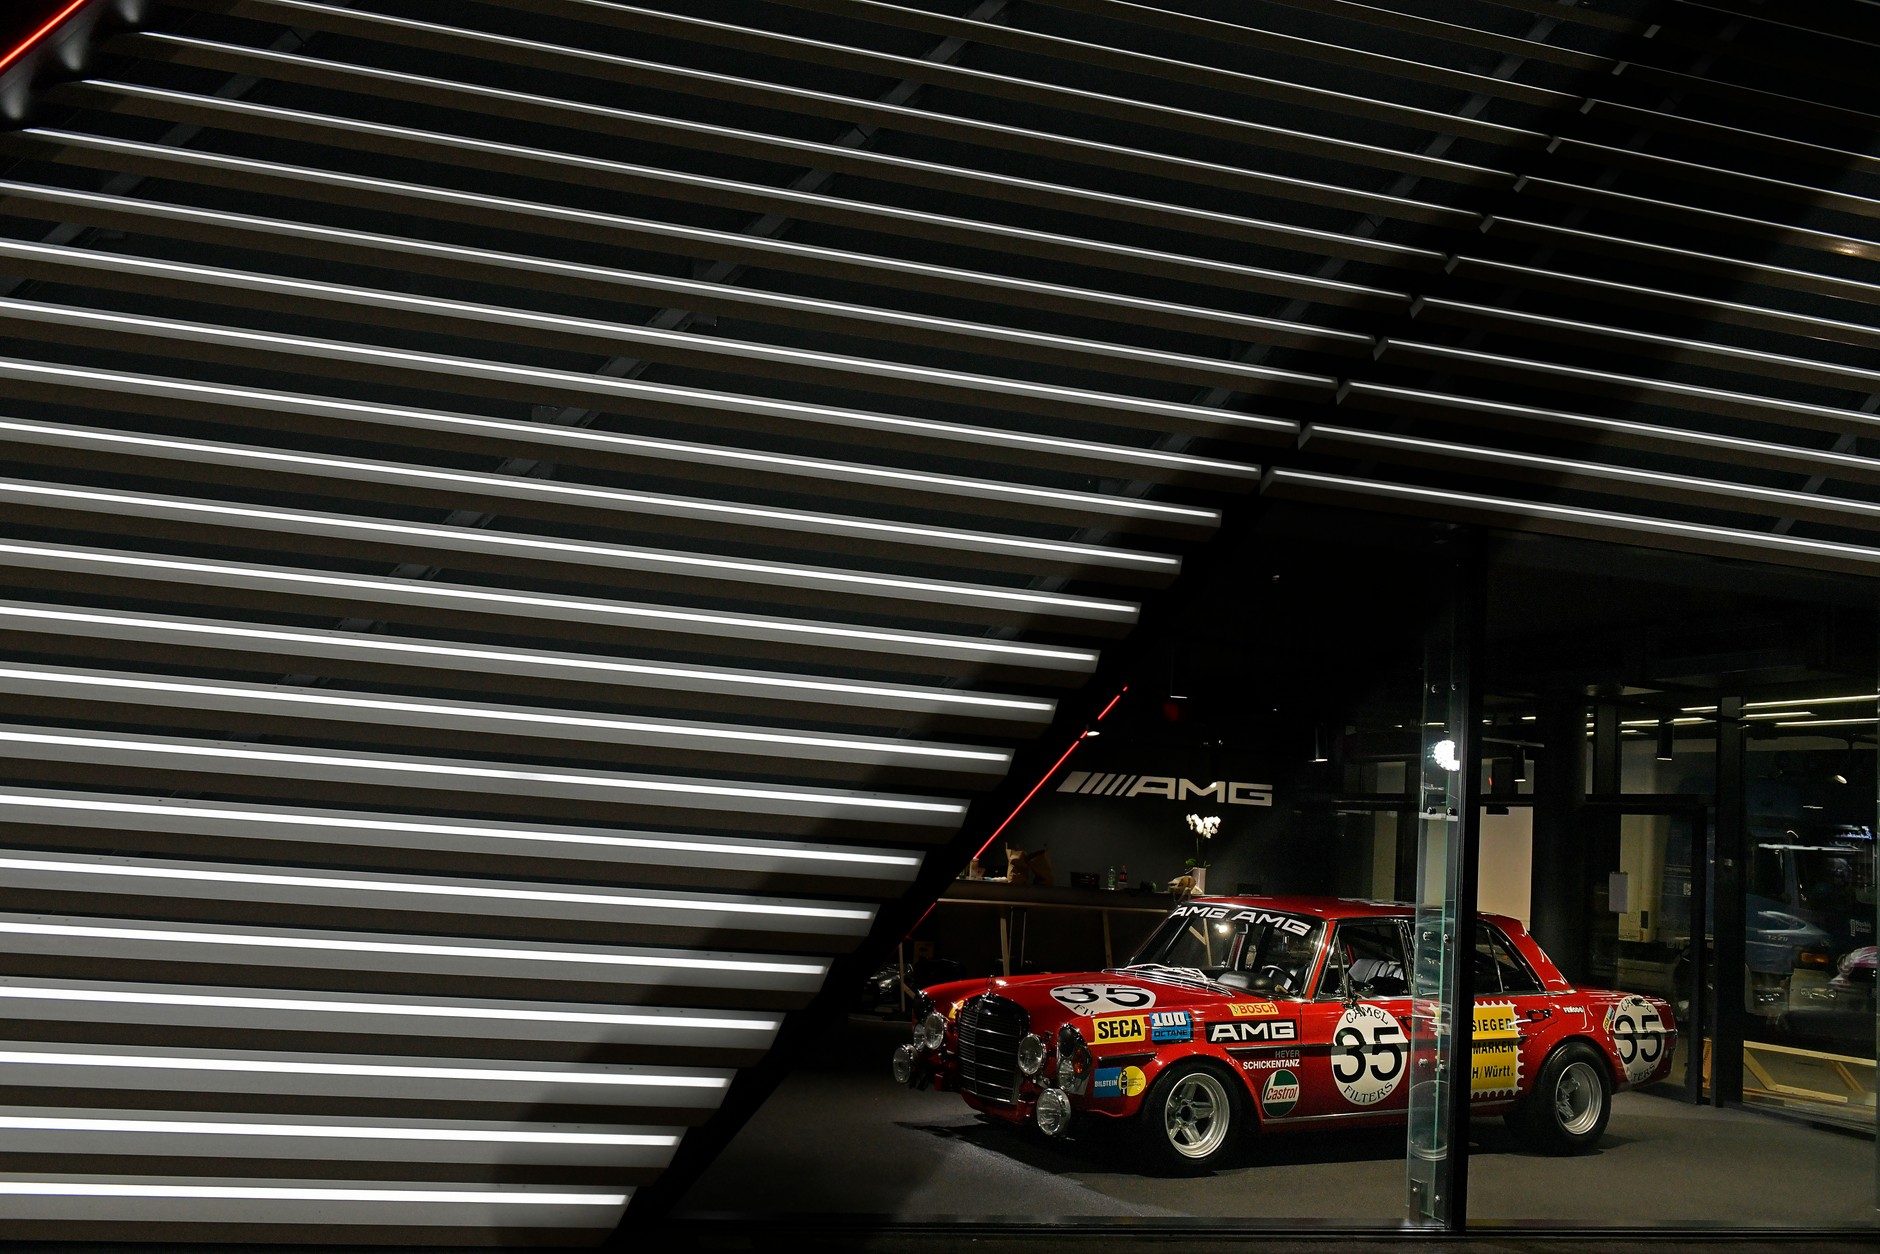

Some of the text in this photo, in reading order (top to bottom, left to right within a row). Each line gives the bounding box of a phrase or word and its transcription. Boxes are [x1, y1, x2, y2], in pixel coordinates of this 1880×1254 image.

[1125, 775, 1273, 807] AMG
[1168, 905, 1312, 937] AMG AMG
[1053, 986, 1151, 1007] 35
[1239, 1003, 1278, 1015] BOSCH
[1345, 1006, 1389, 1025] CAMEL
[1151, 1011, 1188, 1027] 100
[1472, 1018, 1513, 1032] SIEGER
[1097, 1019, 1142, 1040] SECA
[1154, 1029, 1188, 1038] OCTANE
[1210, 1021, 1295, 1042] AMG
[1472, 1040, 1515, 1055] MARKEN
[1614, 1014, 1662, 1064] 35
[1275, 1049, 1300, 1058] HEYER
[1333, 1026, 1403, 1084] 35
[1242, 1058, 1300, 1070] SCHICKENTANZ
[1094, 1079, 1118, 1088] BILSTEIN
[1343, 1081, 1394, 1103] FILTERS
[1265, 1086, 1299, 1101] Castrol
